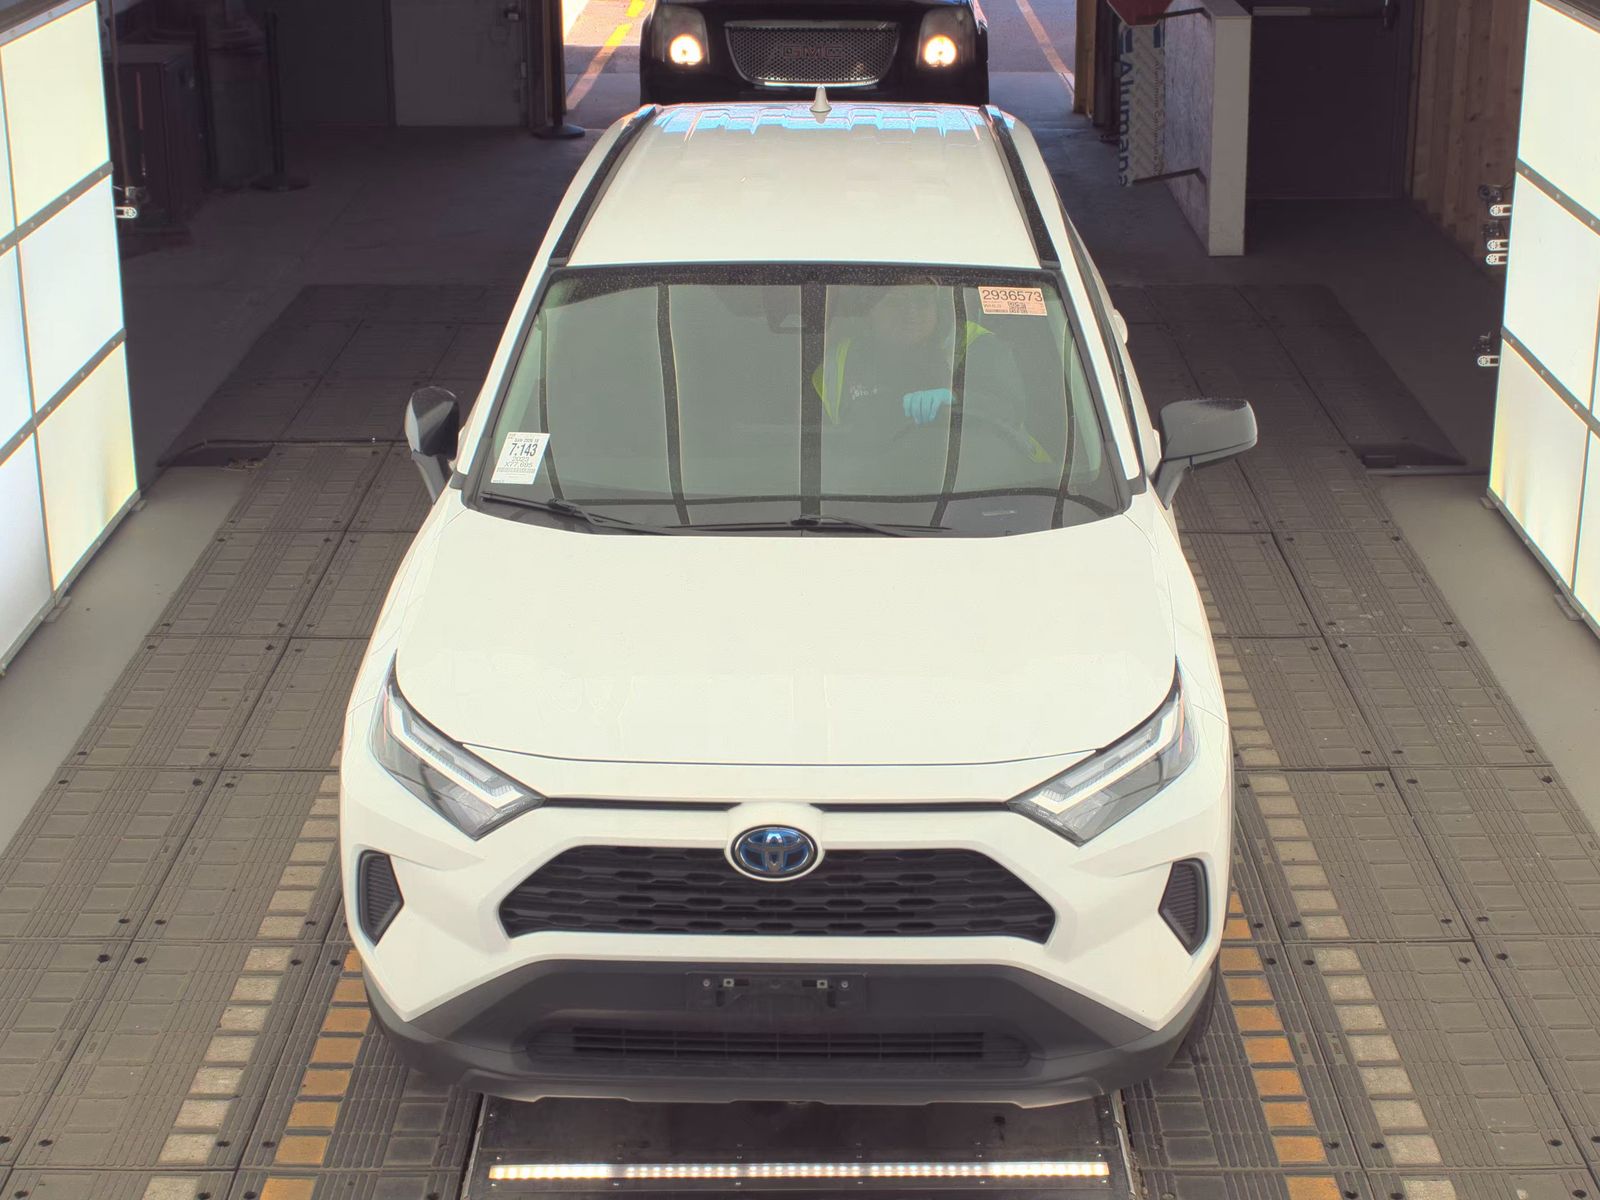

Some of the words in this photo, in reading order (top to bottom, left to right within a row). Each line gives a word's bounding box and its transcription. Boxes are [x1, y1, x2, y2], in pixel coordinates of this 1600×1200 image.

[783, 45, 842, 58] GMC
[982, 289, 1043, 301] 2936573
[509, 442, 538, 457] 7:143
